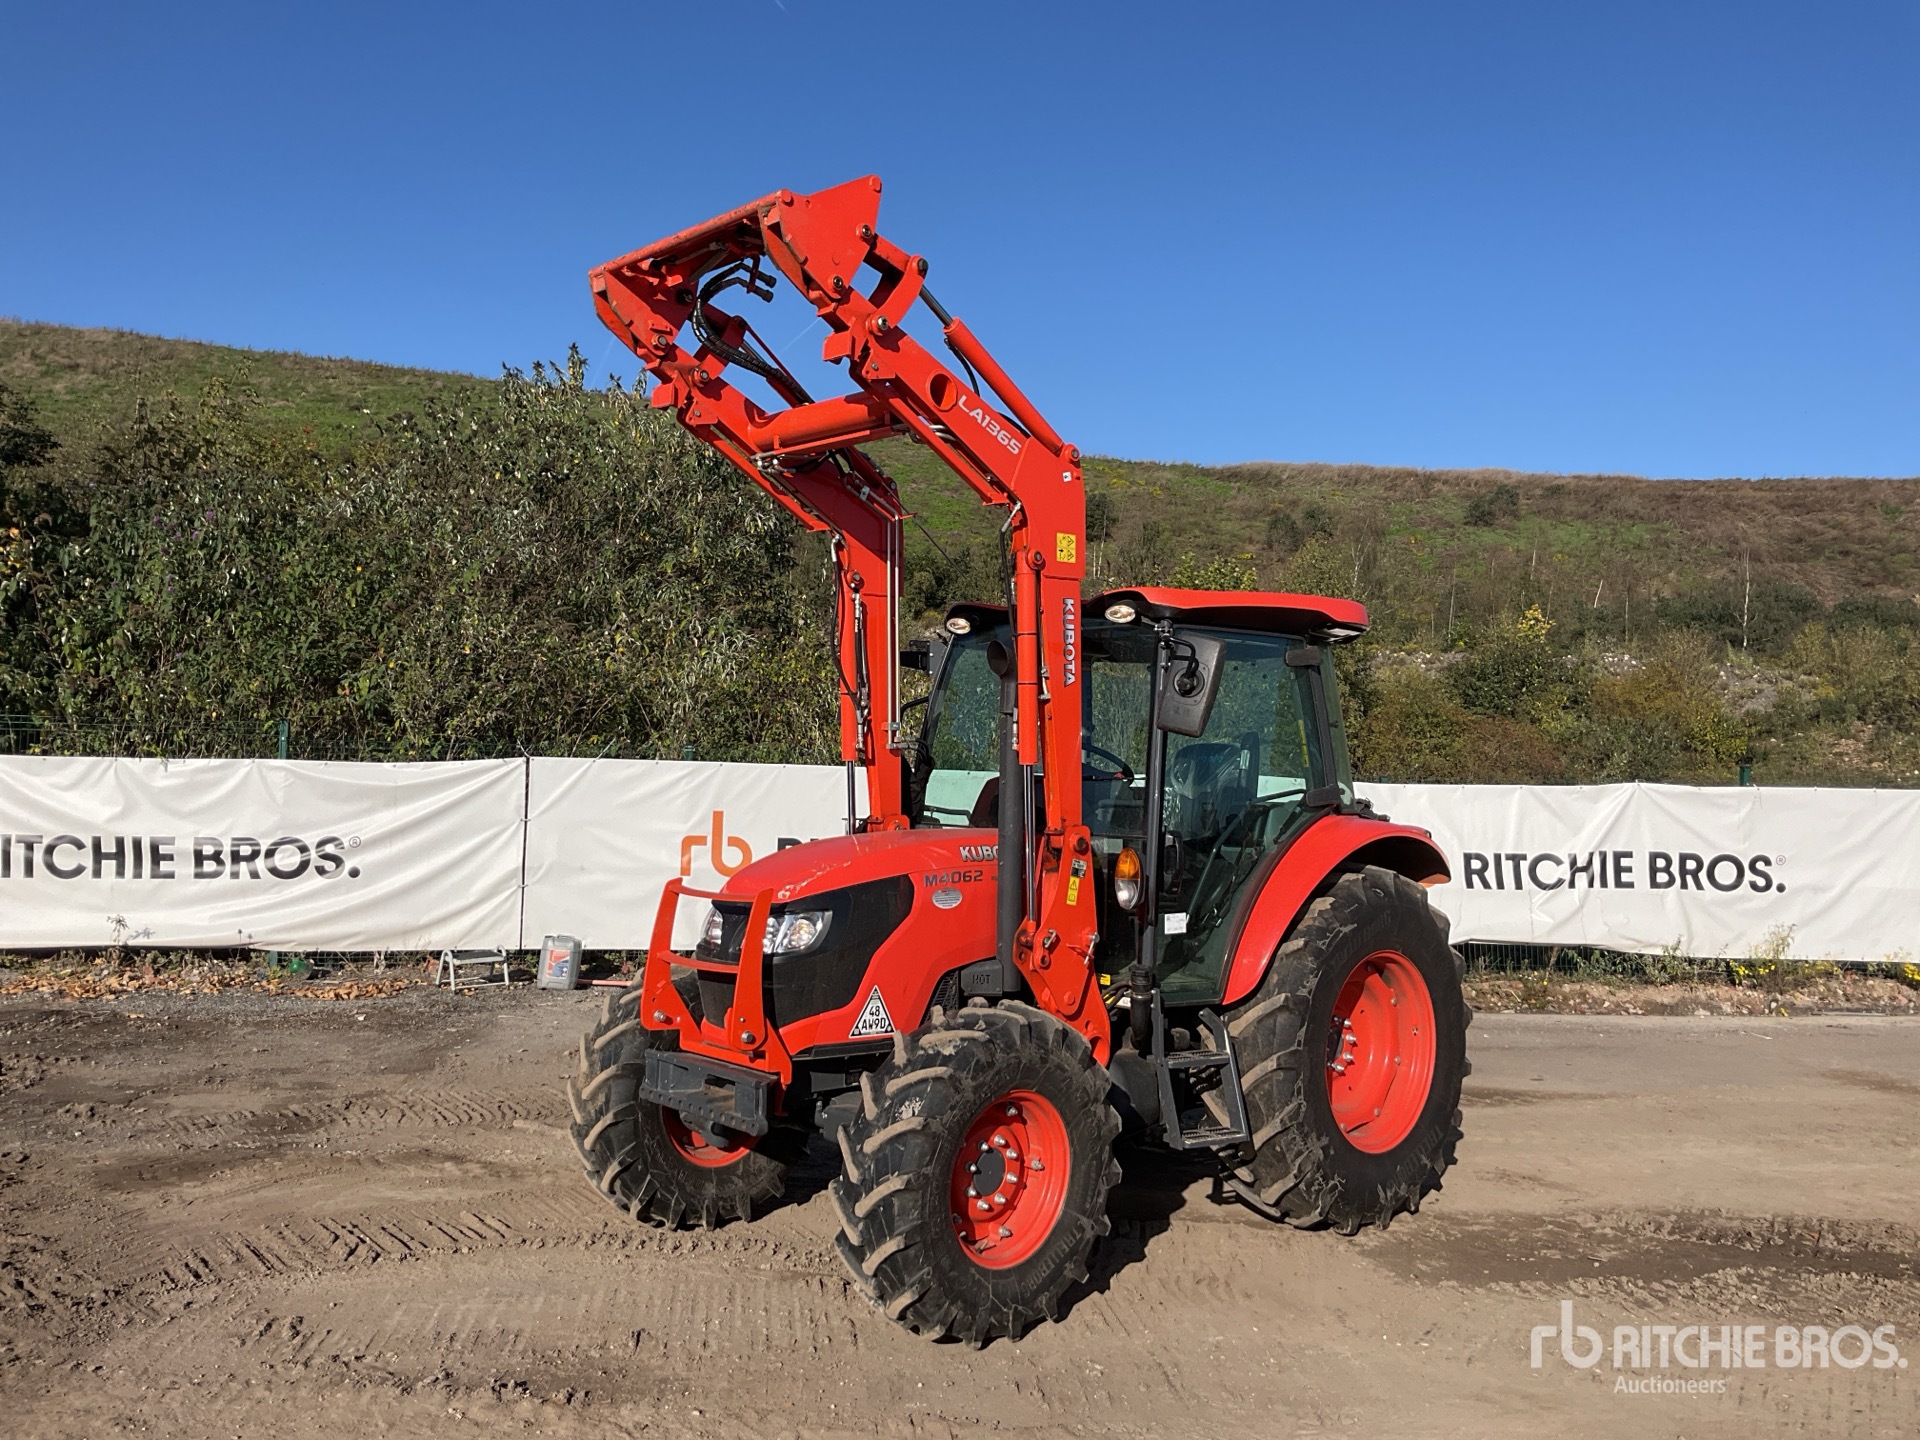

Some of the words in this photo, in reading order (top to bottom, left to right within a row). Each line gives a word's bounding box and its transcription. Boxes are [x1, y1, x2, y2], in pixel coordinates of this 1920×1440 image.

[958, 394, 1022, 455] LA1365
[1063, 598, 1076, 688] KUBOTA
[0, 834, 176, 879] ITCHIE
[680, 811, 752, 877] rb
[959, 845, 998, 862] KUB
[925, 870, 983, 887] M4062
[1463, 851, 1634, 890] RITCHIE
[869, 1005, 880, 1017] 48
